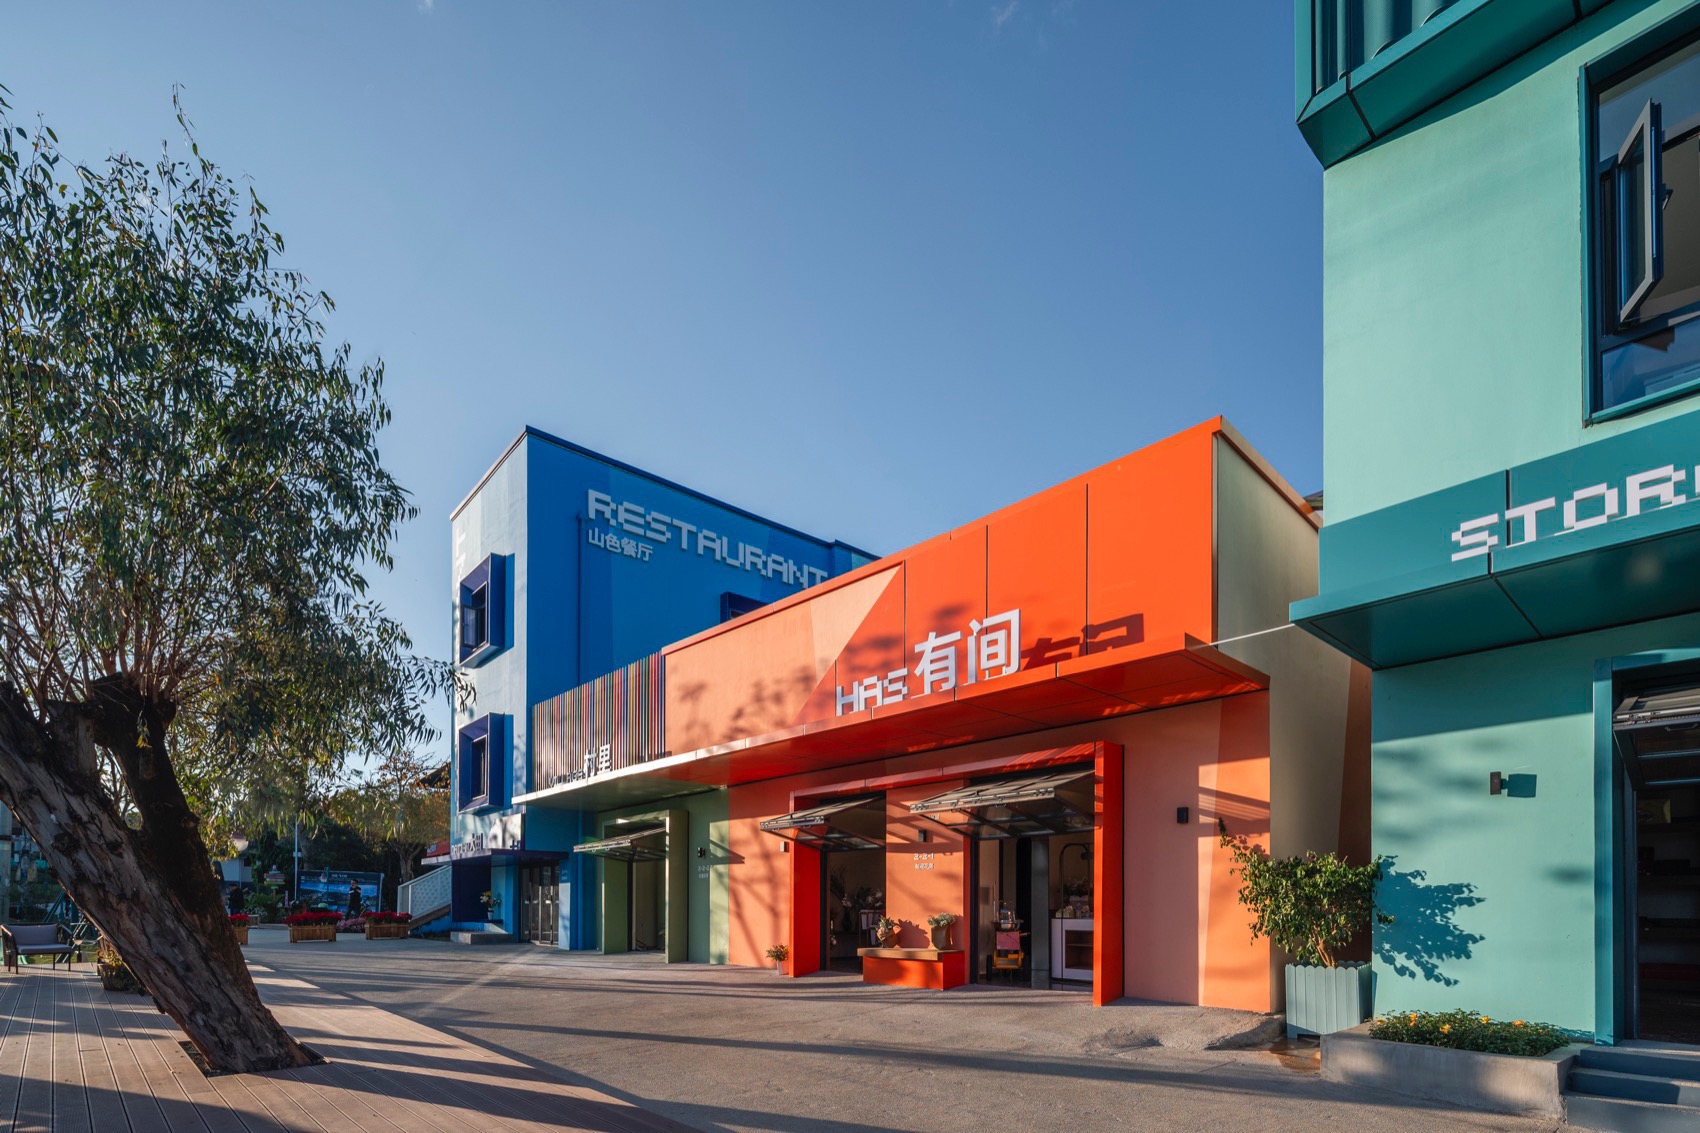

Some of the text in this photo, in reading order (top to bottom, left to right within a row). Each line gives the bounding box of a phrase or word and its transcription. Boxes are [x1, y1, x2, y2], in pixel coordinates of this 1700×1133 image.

[587, 488, 828, 589] RESTAURANT
[588, 527, 653, 562] 山色餐厅
[1451, 463, 1700, 562] STOR
[836, 607, 1020, 717] HAS 有间
